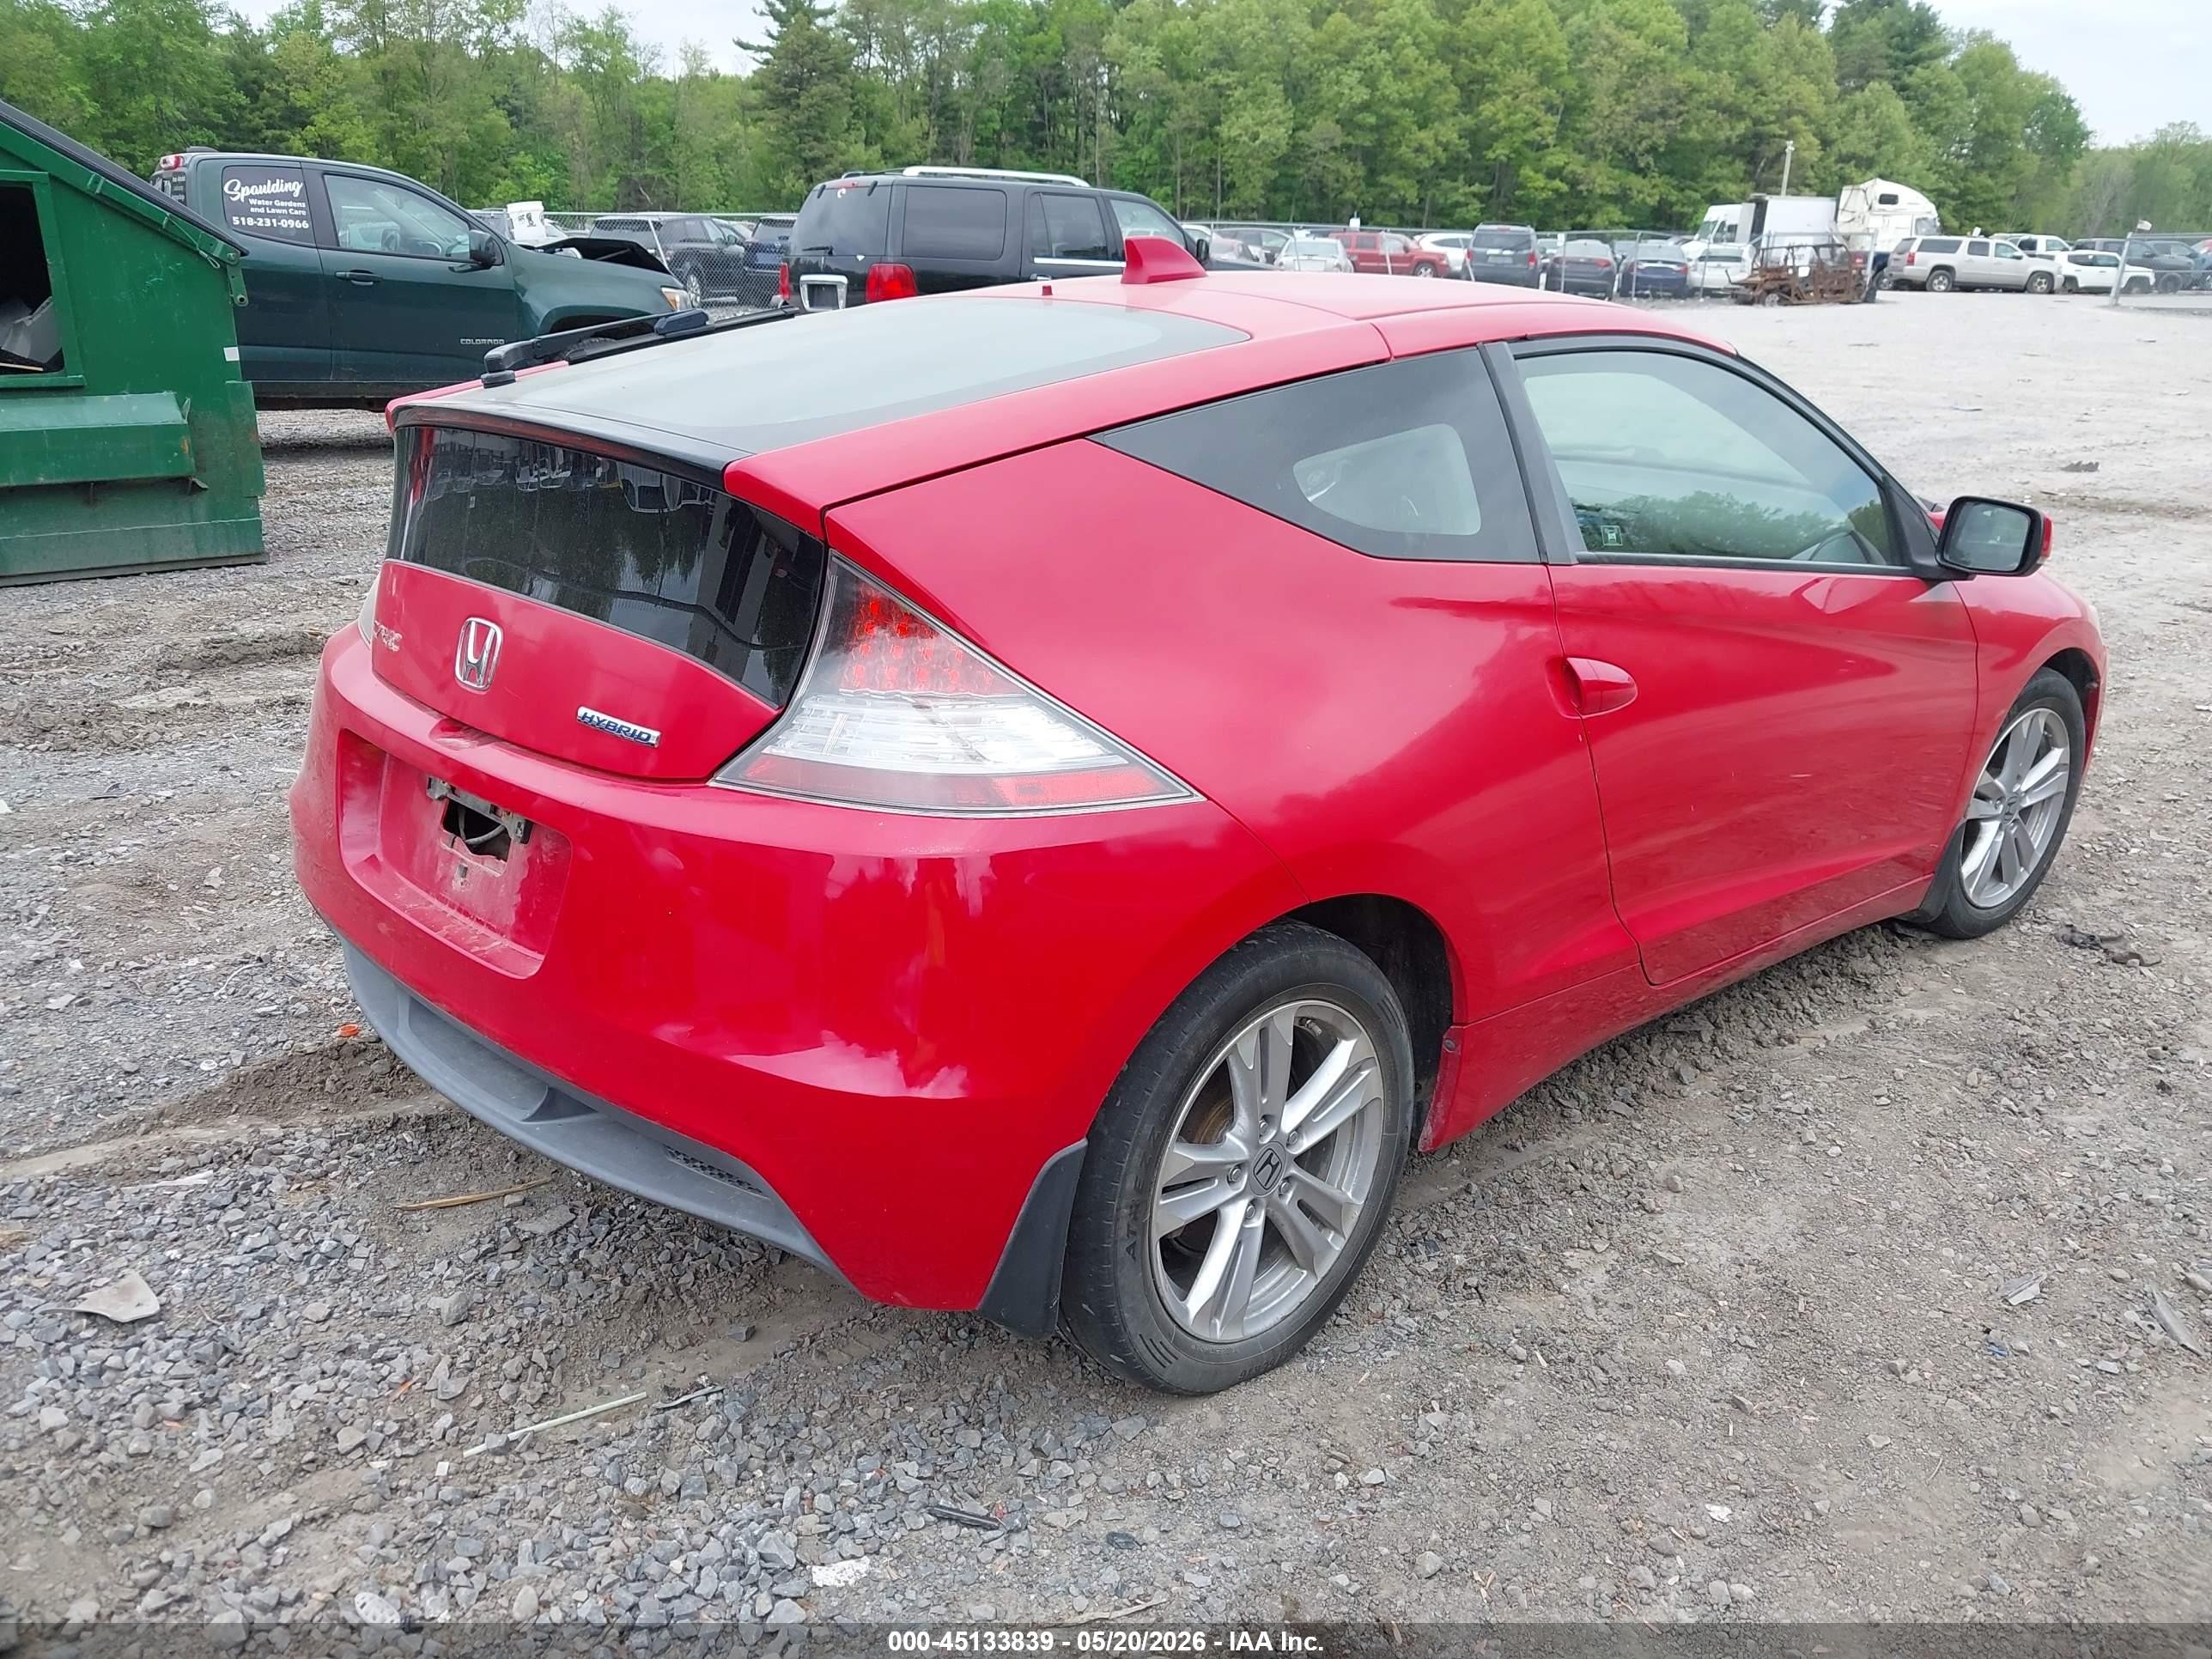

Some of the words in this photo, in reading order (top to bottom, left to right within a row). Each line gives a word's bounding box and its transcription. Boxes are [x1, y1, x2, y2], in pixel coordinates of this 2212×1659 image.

[224, 179, 303, 202] Spaulding
[232, 216, 309, 229] 518-231-0966
[580, 712, 652, 742] HYBRID
